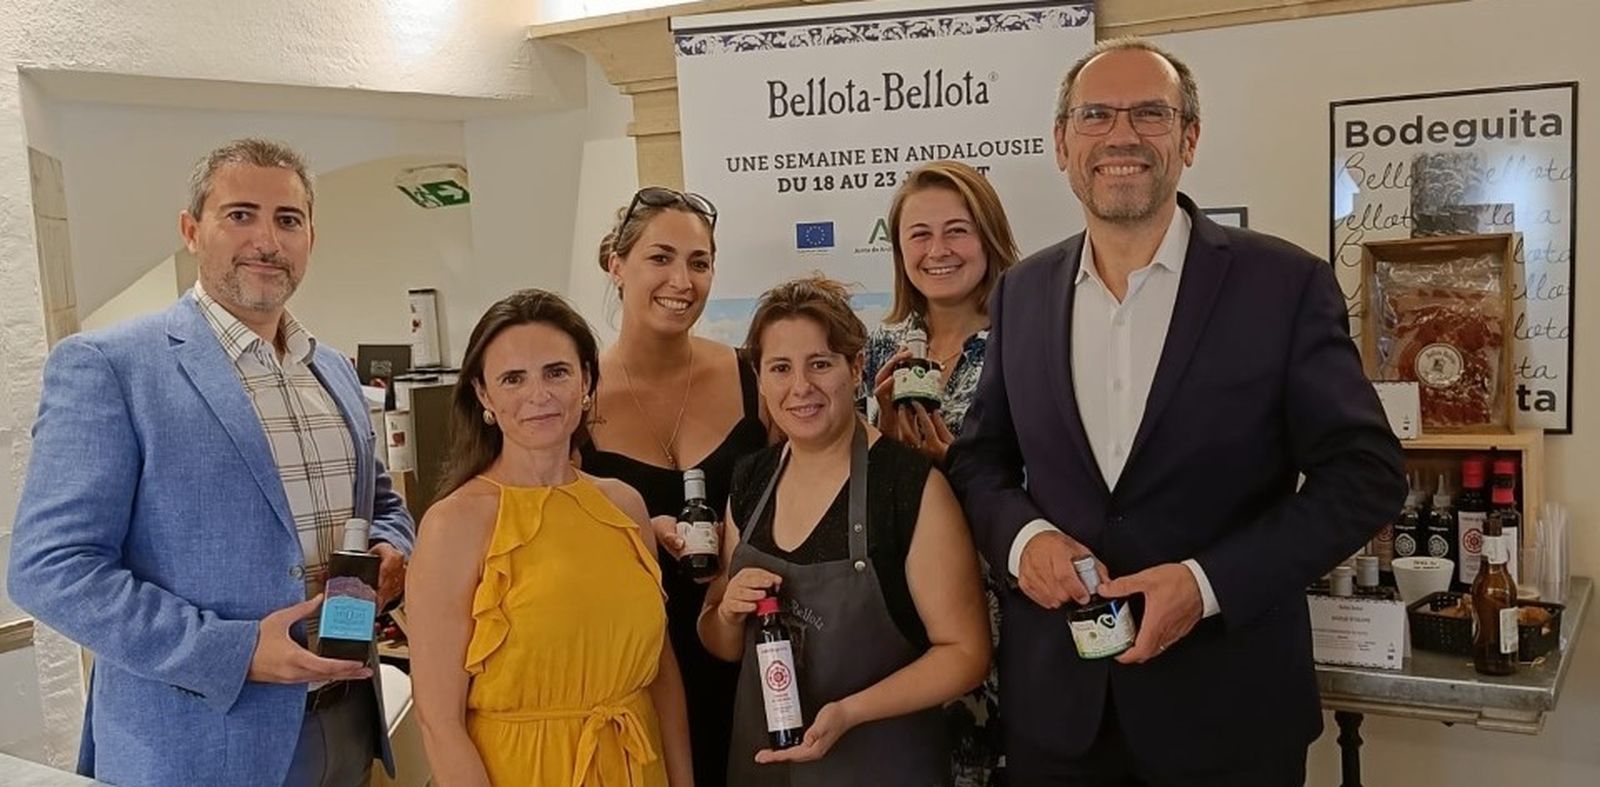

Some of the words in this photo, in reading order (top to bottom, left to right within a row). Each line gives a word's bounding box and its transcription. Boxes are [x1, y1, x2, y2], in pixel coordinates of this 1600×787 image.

[767, 69, 989, 119] Bellota-Bellota
[1345, 108, 1563, 148] Bodeguita
[726, 155, 769, 172] UNE
[774, 150, 866, 170] SEMAINE
[871, 147, 899, 164] EN
[905, 138, 1044, 162] ANDALOUSIE
[778, 177, 807, 193] DU
[813, 175, 834, 191] 18
[840, 173, 868, 190] AU
[874, 171, 897, 188] 23
